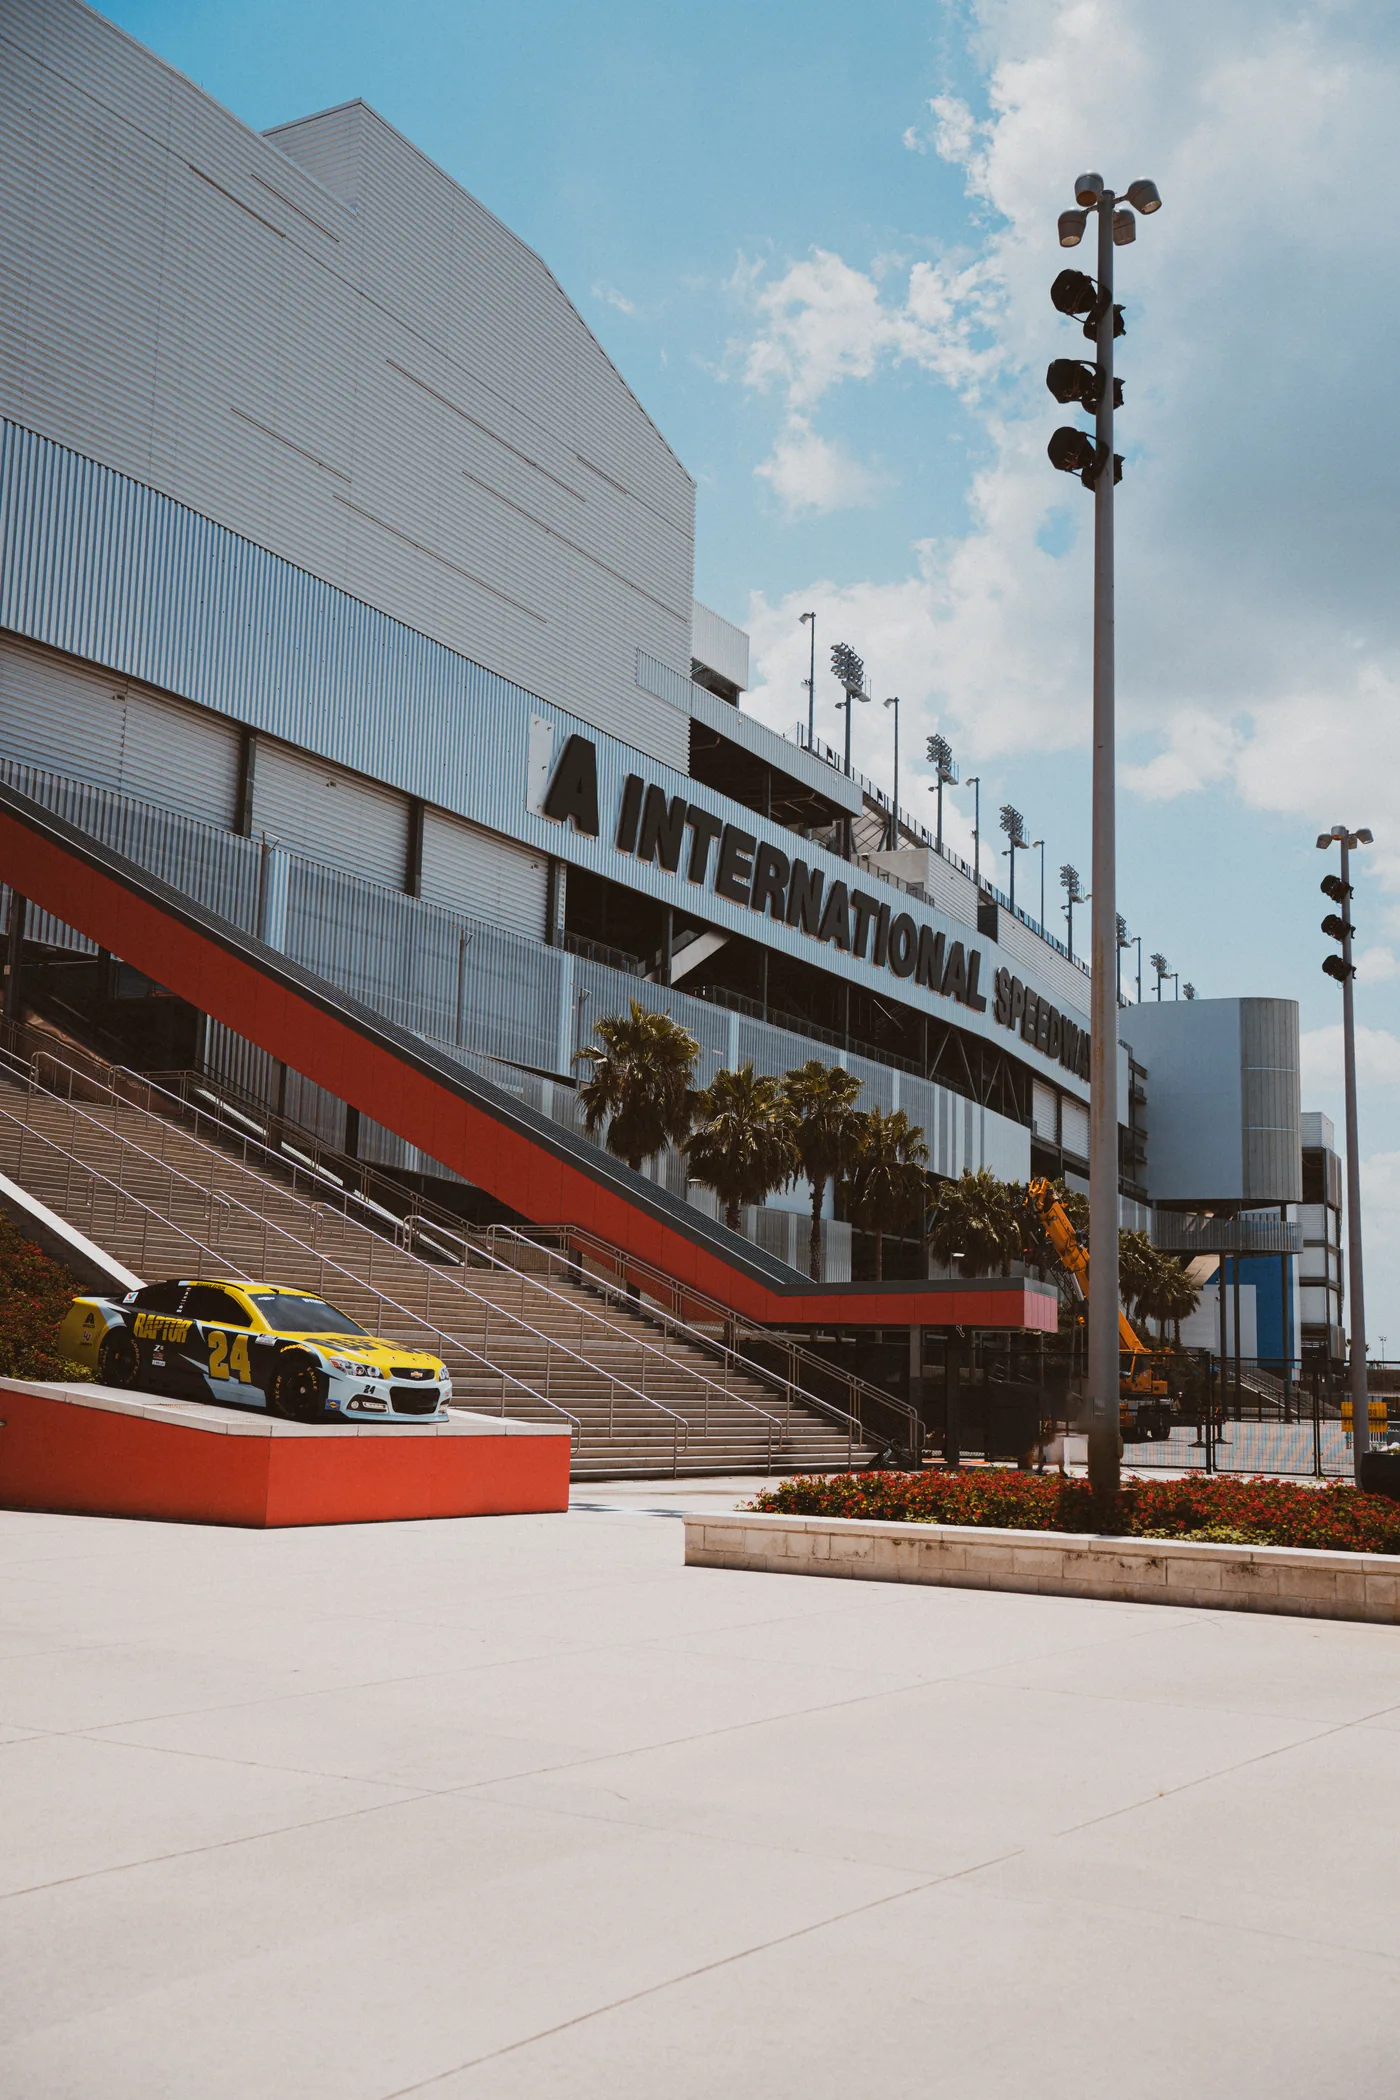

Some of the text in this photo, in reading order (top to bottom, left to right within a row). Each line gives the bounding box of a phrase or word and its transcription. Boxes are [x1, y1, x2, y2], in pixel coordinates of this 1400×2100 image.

[544, 734, 1091, 1083] A INTERNATIONAL SPEEDWA
[133, 1313, 194, 1344] RAPTOR
[208, 1331, 252, 1384] 24
[363, 1384, 376, 1395] 24
